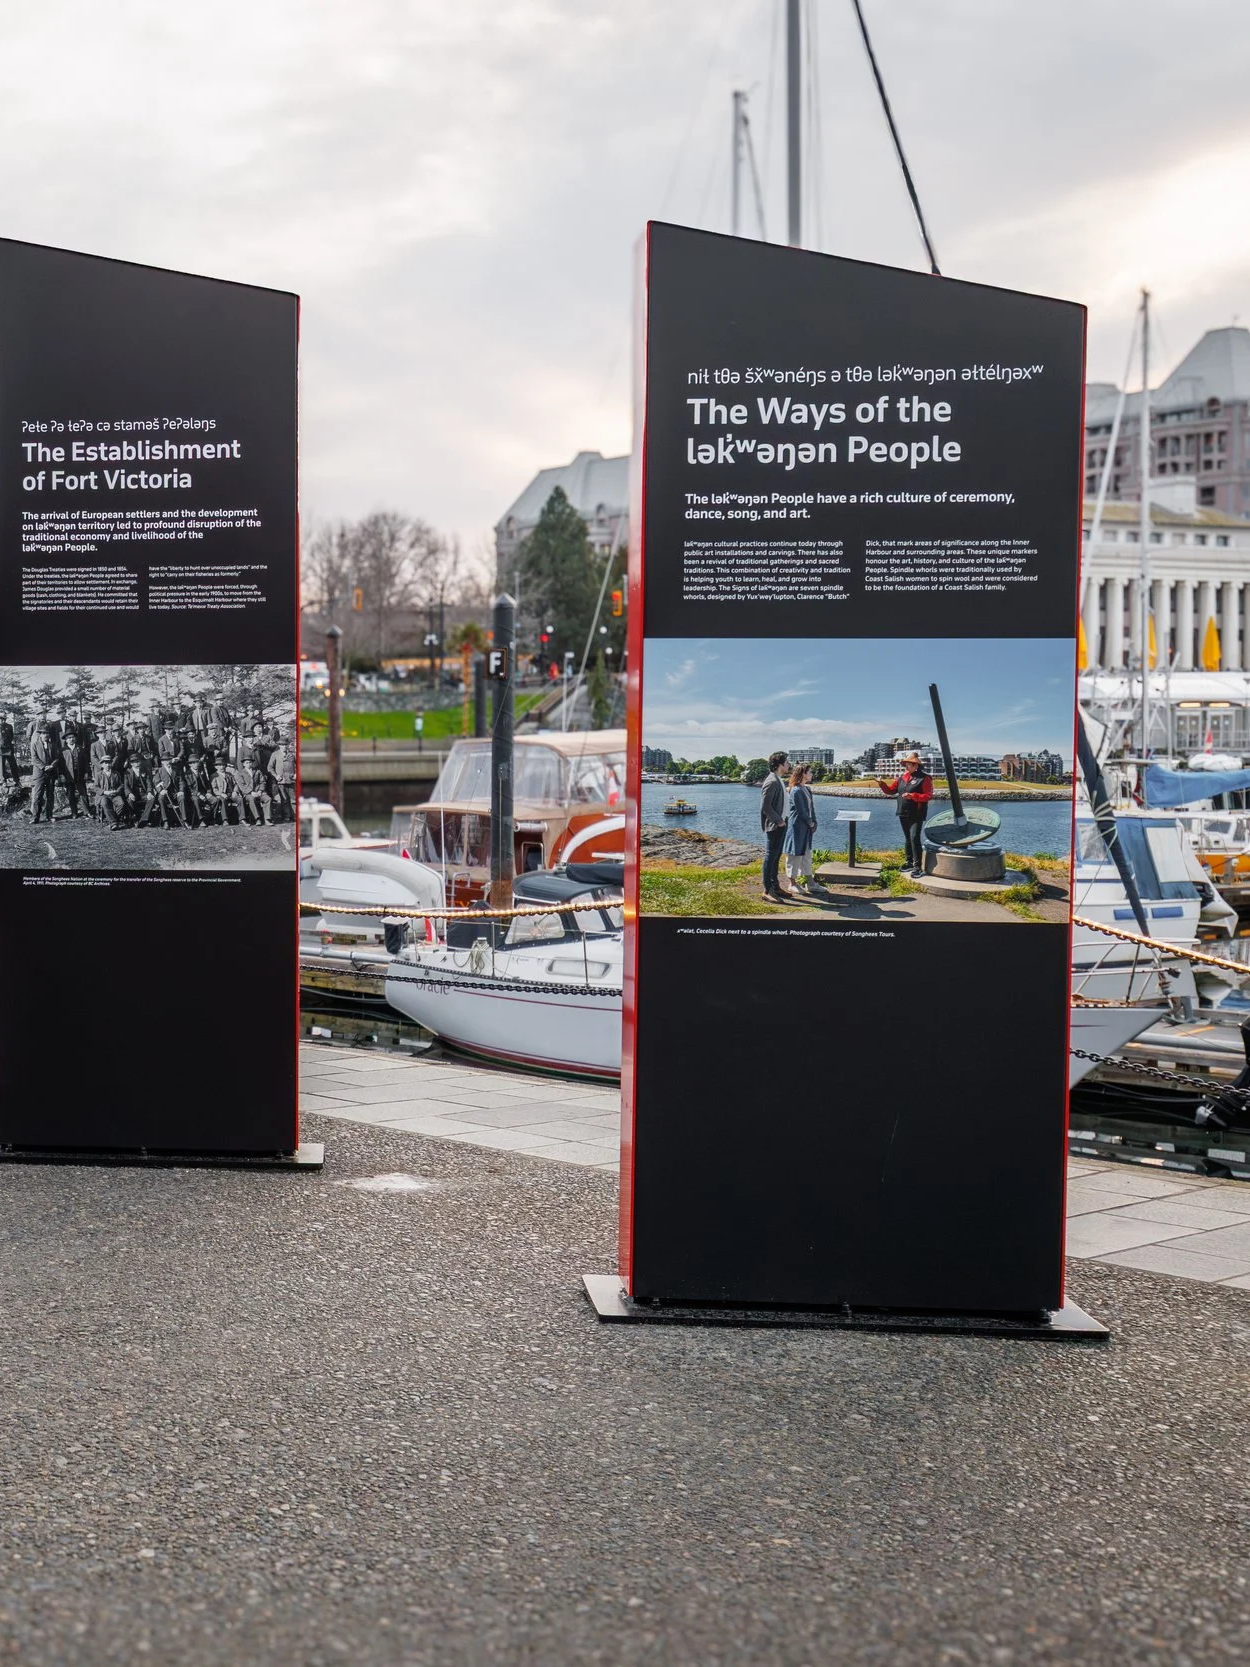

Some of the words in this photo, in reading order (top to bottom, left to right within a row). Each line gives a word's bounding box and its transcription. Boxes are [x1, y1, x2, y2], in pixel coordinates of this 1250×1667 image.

[686, 398, 748, 425] The
[756, 397, 846, 429] Ways
[855, 395, 889, 423] of
[896, 395, 951, 423] the
[22, 443, 65, 462] The
[72, 440, 241, 461] Establishment
[849, 435, 960, 469] People
[22, 471, 46, 491] of
[52, 471, 98, 490] Fort
[103, 468, 192, 489] Victoria
[685, 493, 709, 504] The
[771, 493, 814, 506] People
[817, 492, 847, 503] have
[849, 495, 857, 503] a
[860, 492, 883, 503] rich
[886, 492, 931, 503] culture
[933, 492, 947, 503] of
[949, 493, 1015, 504] ceremony,
[22, 512, 39, 520] The
[40, 511, 69, 520] arrival
[70, 511, 80, 519] of
[81, 511, 124, 521] European
[125, 510, 160, 519] settlers
[162, 509, 179, 518] and
[180, 509, 196, 518] the
[198, 508, 258, 520] development
[685, 508, 725, 520] dance,
[728, 508, 761, 521] song,
[763, 508, 786, 518] and
[790, 508, 810, 518] art.
[77, 520, 115, 531] territory
[116, 521, 131, 529] led
[132, 521, 142, 529] to
[144, 520, 185, 531] profound
[187, 519, 233, 530] disruption
[235, 519, 245, 527] of
[246, 519, 261, 527] the
[22, 530, 68, 540] traditional
[70, 531, 111, 542] economy
[113, 531, 129, 540] and
[131, 530, 175, 540] livelihood
[177, 530, 187, 539] of
[188, 531, 203, 539] the
[65, 543, 97, 553] People.
[941, 539, 979, 547] significance
[489, 652, 501, 673] F
